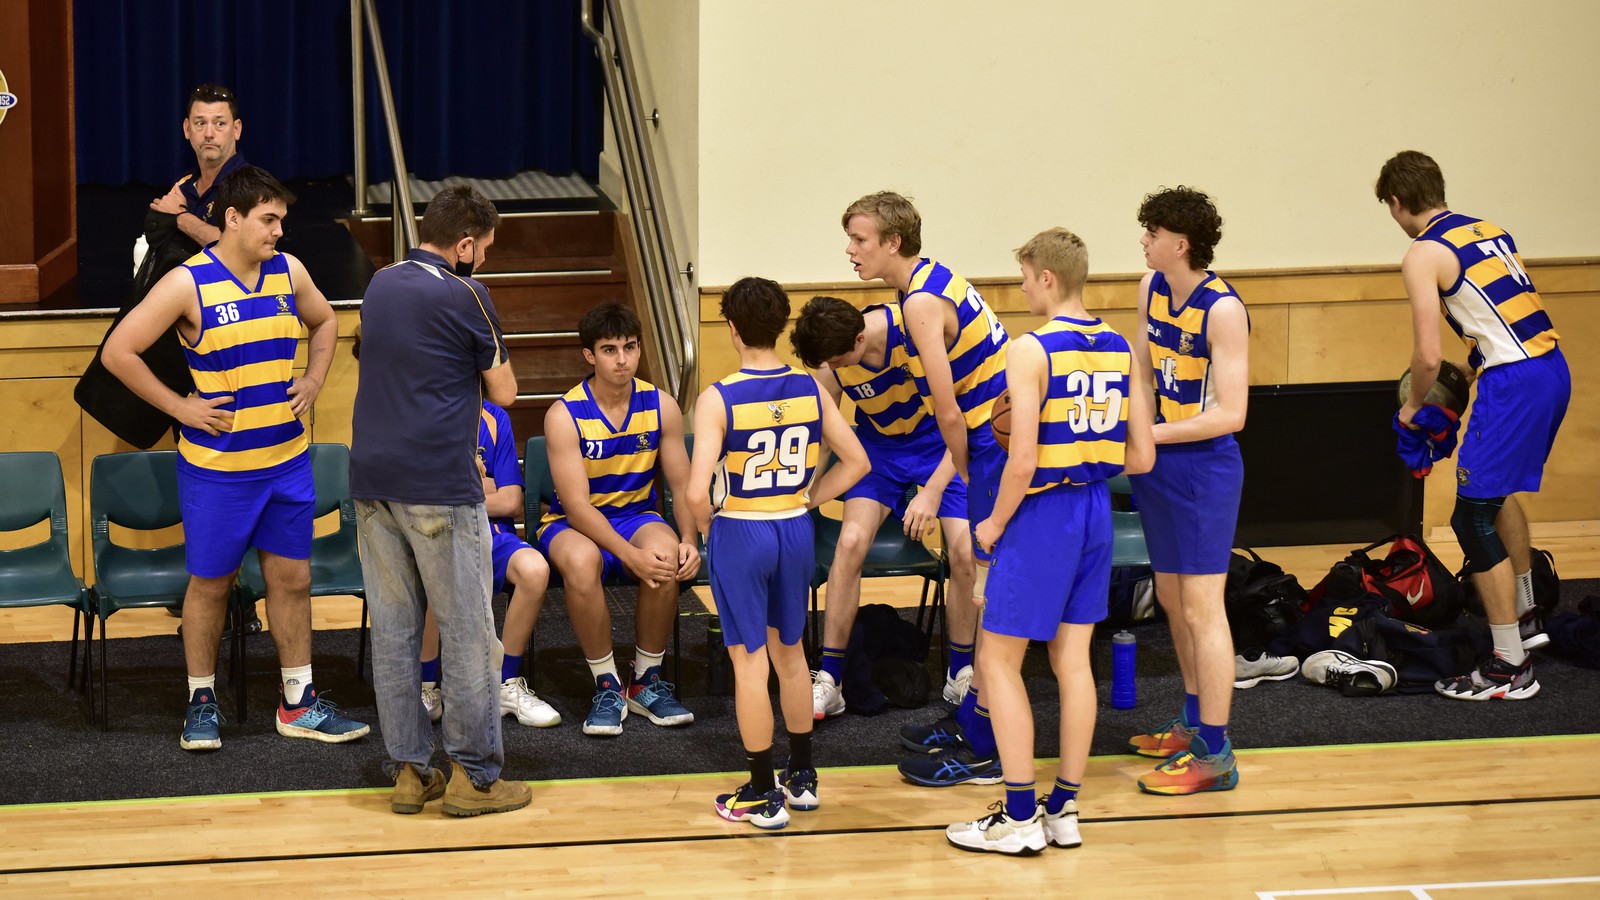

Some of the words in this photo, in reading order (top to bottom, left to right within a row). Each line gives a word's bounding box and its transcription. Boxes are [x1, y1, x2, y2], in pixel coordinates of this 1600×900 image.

[215, 302, 240, 325] 36
[853, 383, 876, 399] 18
[1066, 370, 1123, 434] 35
[742, 425, 810, 491] 29
